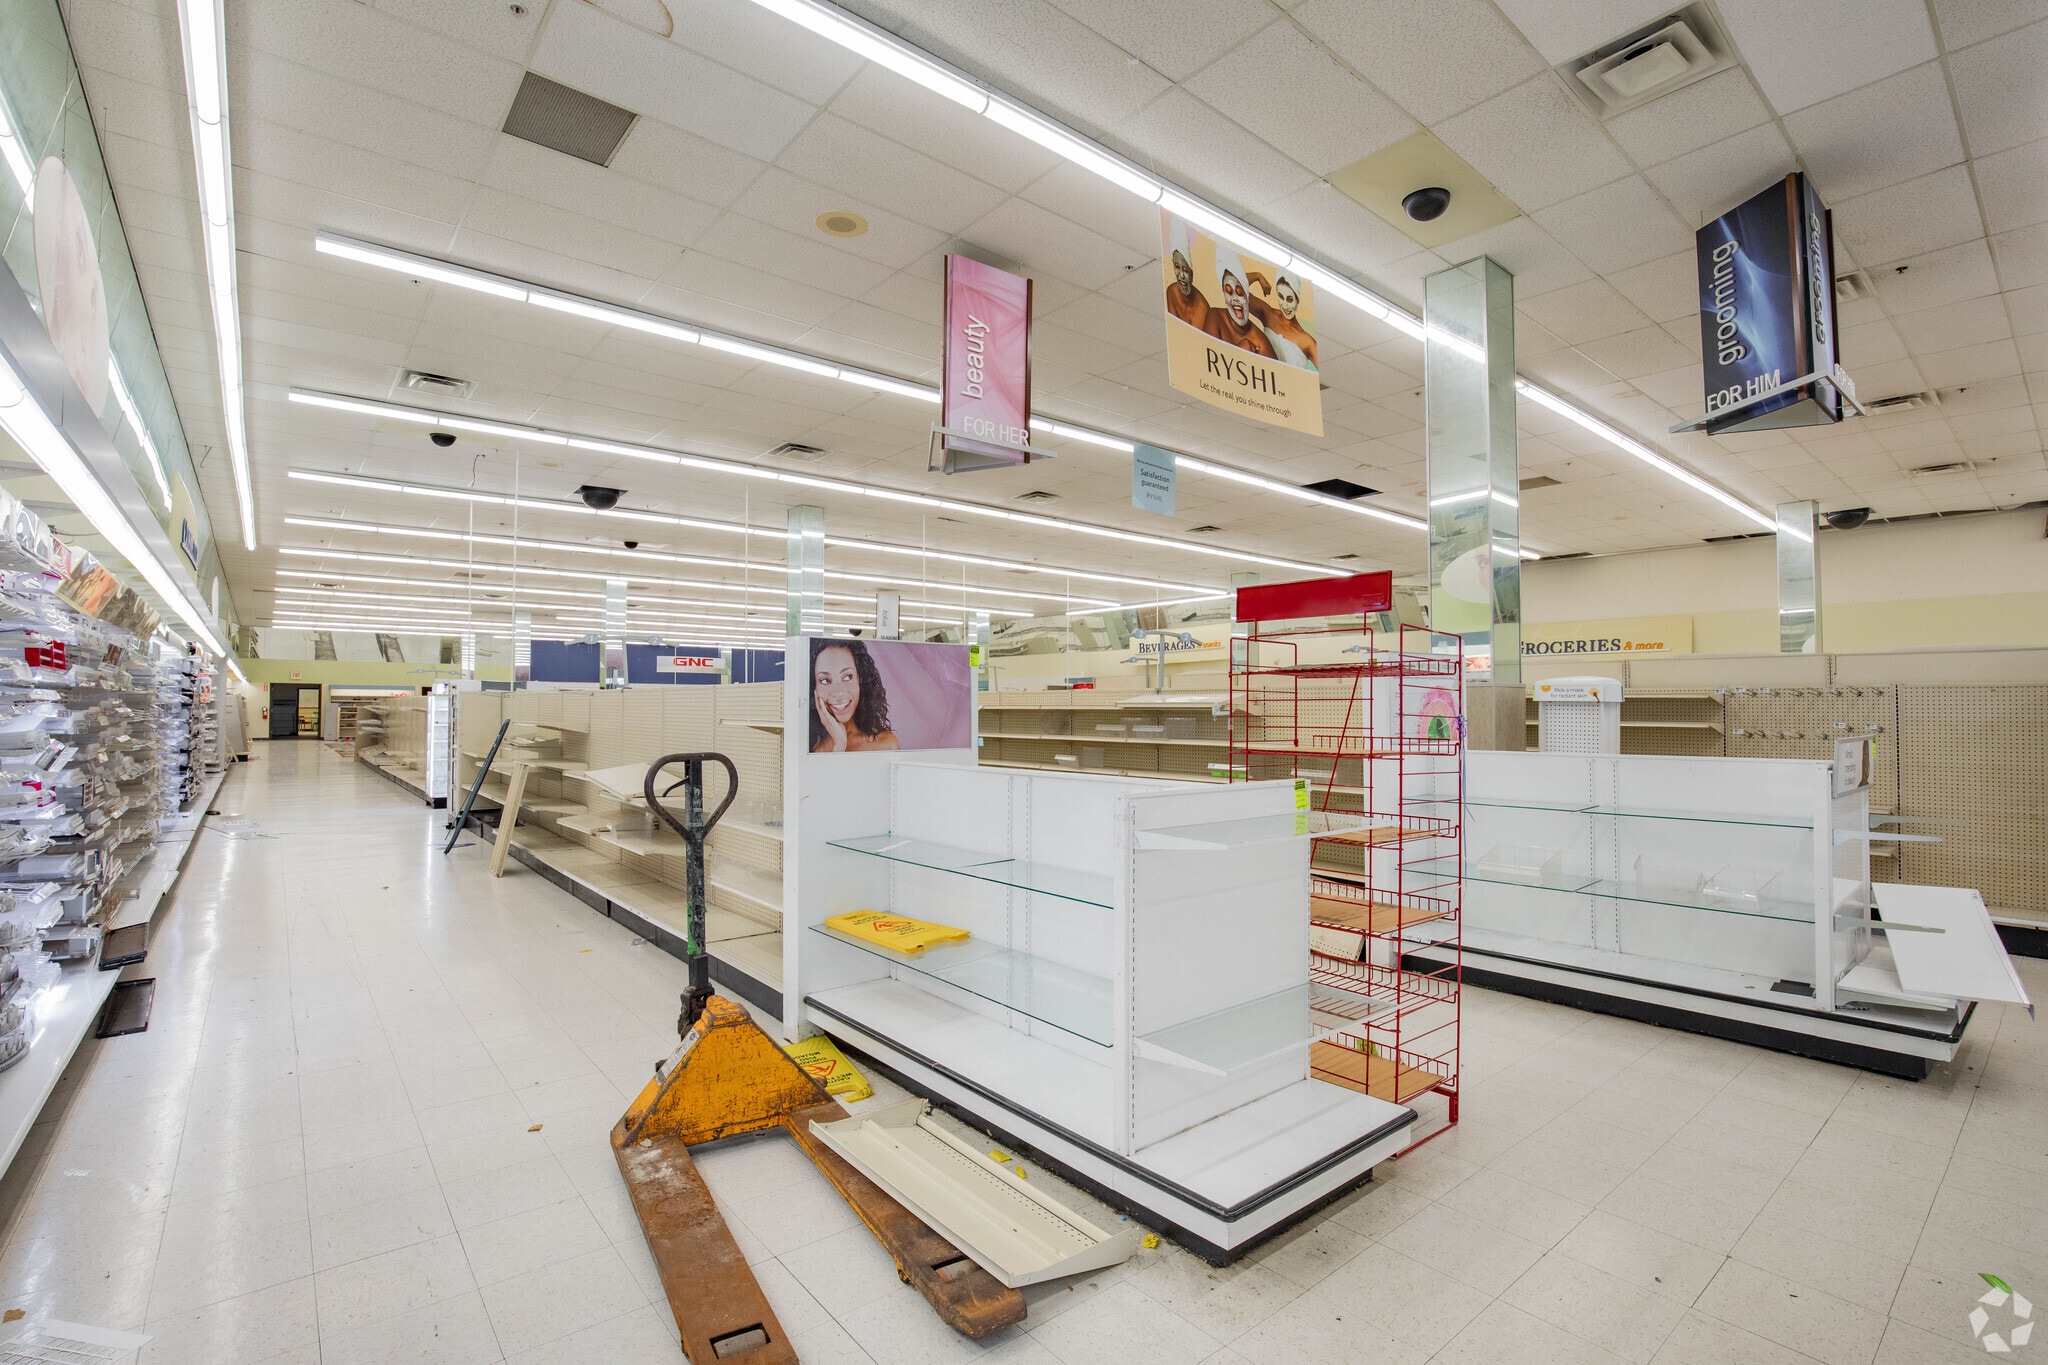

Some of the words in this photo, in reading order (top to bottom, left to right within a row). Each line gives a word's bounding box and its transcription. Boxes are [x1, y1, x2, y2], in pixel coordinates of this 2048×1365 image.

[1708, 240, 1746, 366] grooming
[961, 314, 990, 400] beauty
[1199, 379, 1210, 391] Let
[1210, 385, 1221, 396] the
[1221, 389, 1234, 401] real
[1235, 394, 1247, 405] you
[1247, 398, 1265, 411] shine
[1265, 403, 1292, 418] through
[1706, 384, 1743, 414] FOR
[1746, 369, 1781, 400] HIM
[963, 416, 996, 440] FOR
[999, 425, 1030, 447] HER
[1140, 468, 1170, 484] Satisfaction
[1141, 480, 1169, 492] guaranteed
[881, 609, 889, 627] enjoy
[1623, 641, 1633, 651] &
[1635, 641, 1664, 650] more
[673, 657, 714, 667] GNC
